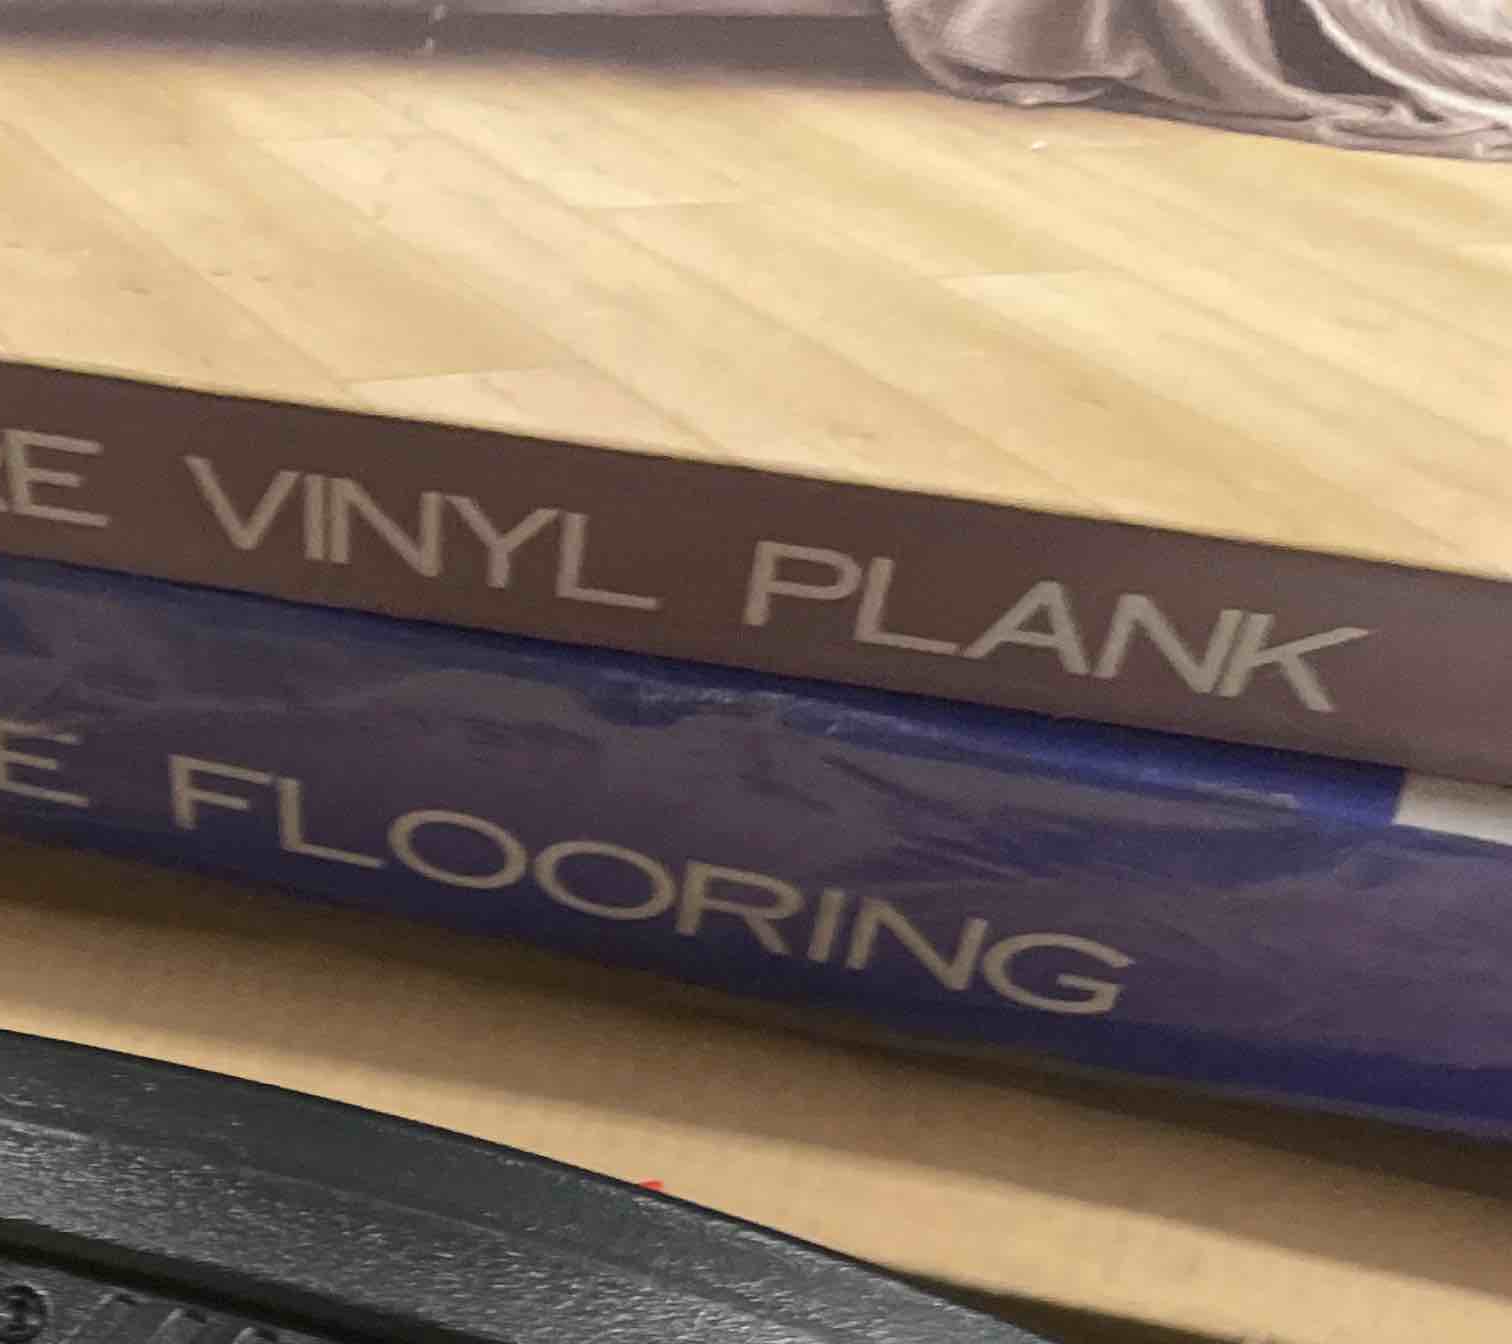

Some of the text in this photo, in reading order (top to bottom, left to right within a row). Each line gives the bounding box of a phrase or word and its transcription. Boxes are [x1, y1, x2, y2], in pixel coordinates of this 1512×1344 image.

[185, 456, 659, 613] VINYL
[742, 539, 1373, 714] PLANK
[168, 754, 1137, 1015] FLOORING
